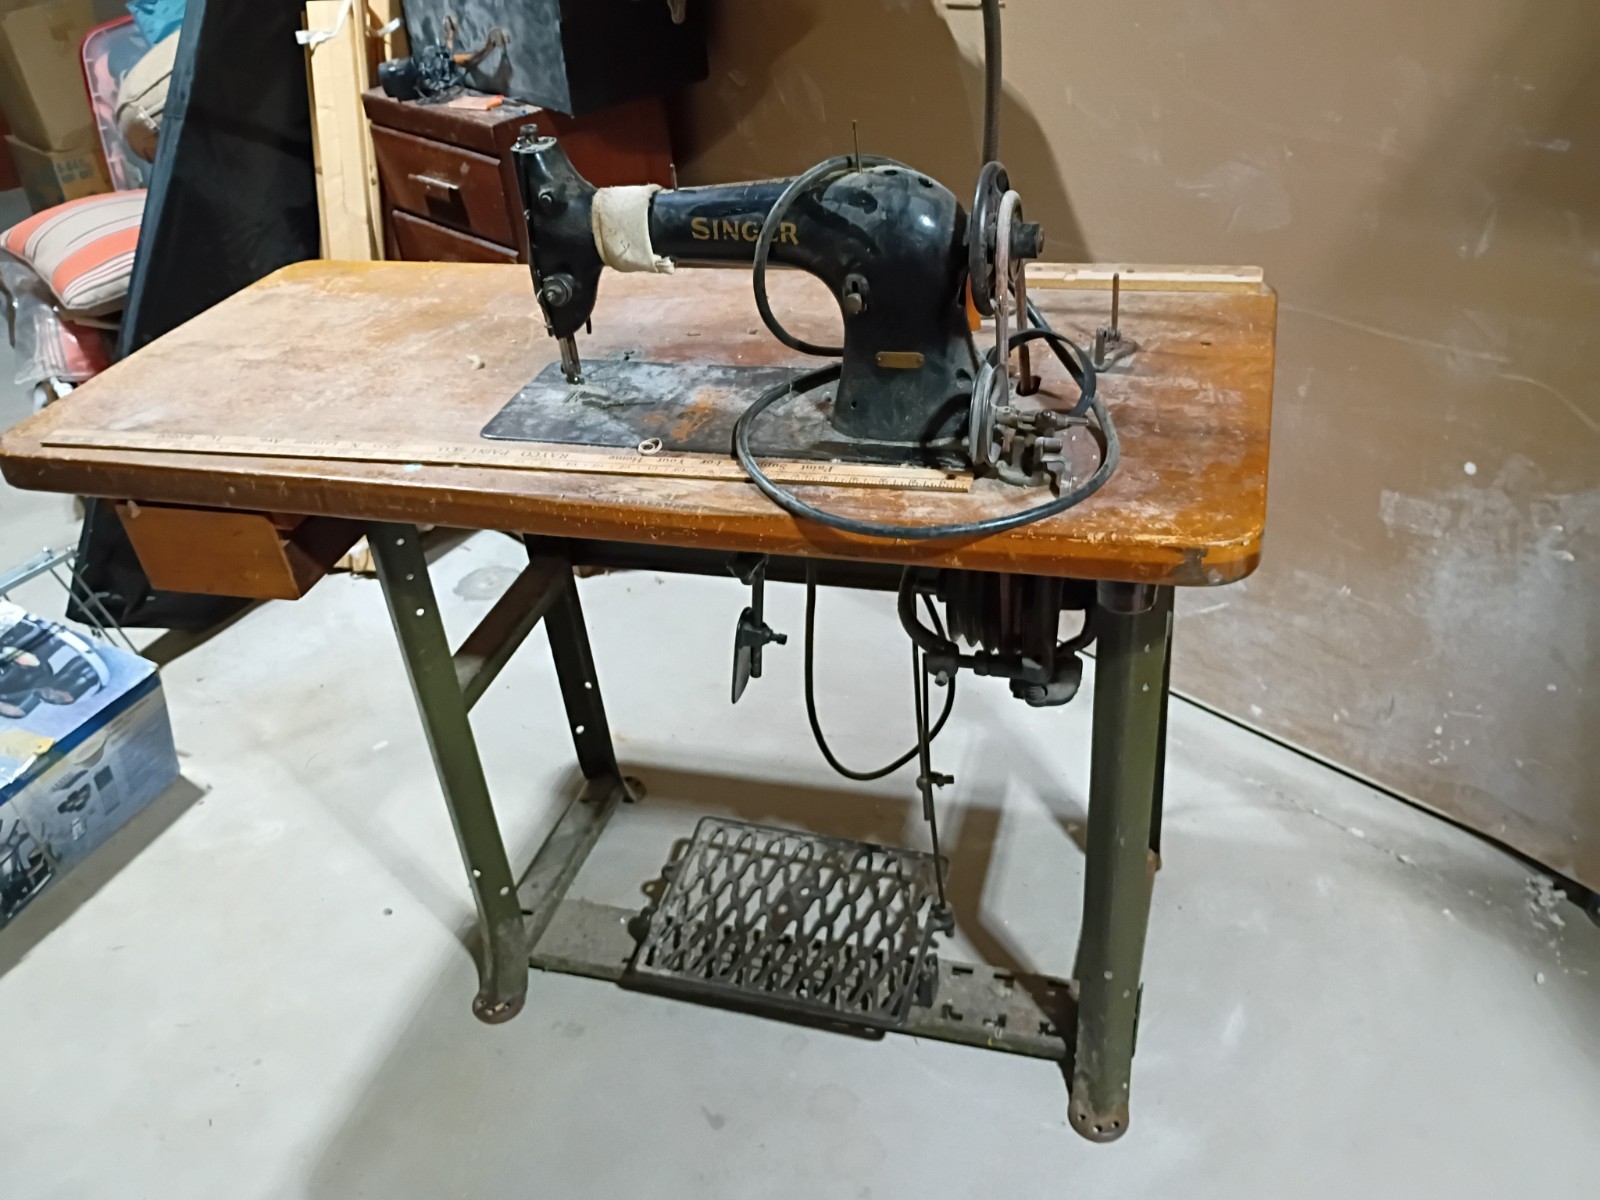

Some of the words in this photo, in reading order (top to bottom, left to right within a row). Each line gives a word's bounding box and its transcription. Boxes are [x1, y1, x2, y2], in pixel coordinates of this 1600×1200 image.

[690, 216, 800, 246] SINGR
[608, 455, 644, 463] Home
[800, 464, 833, 473] Paint
